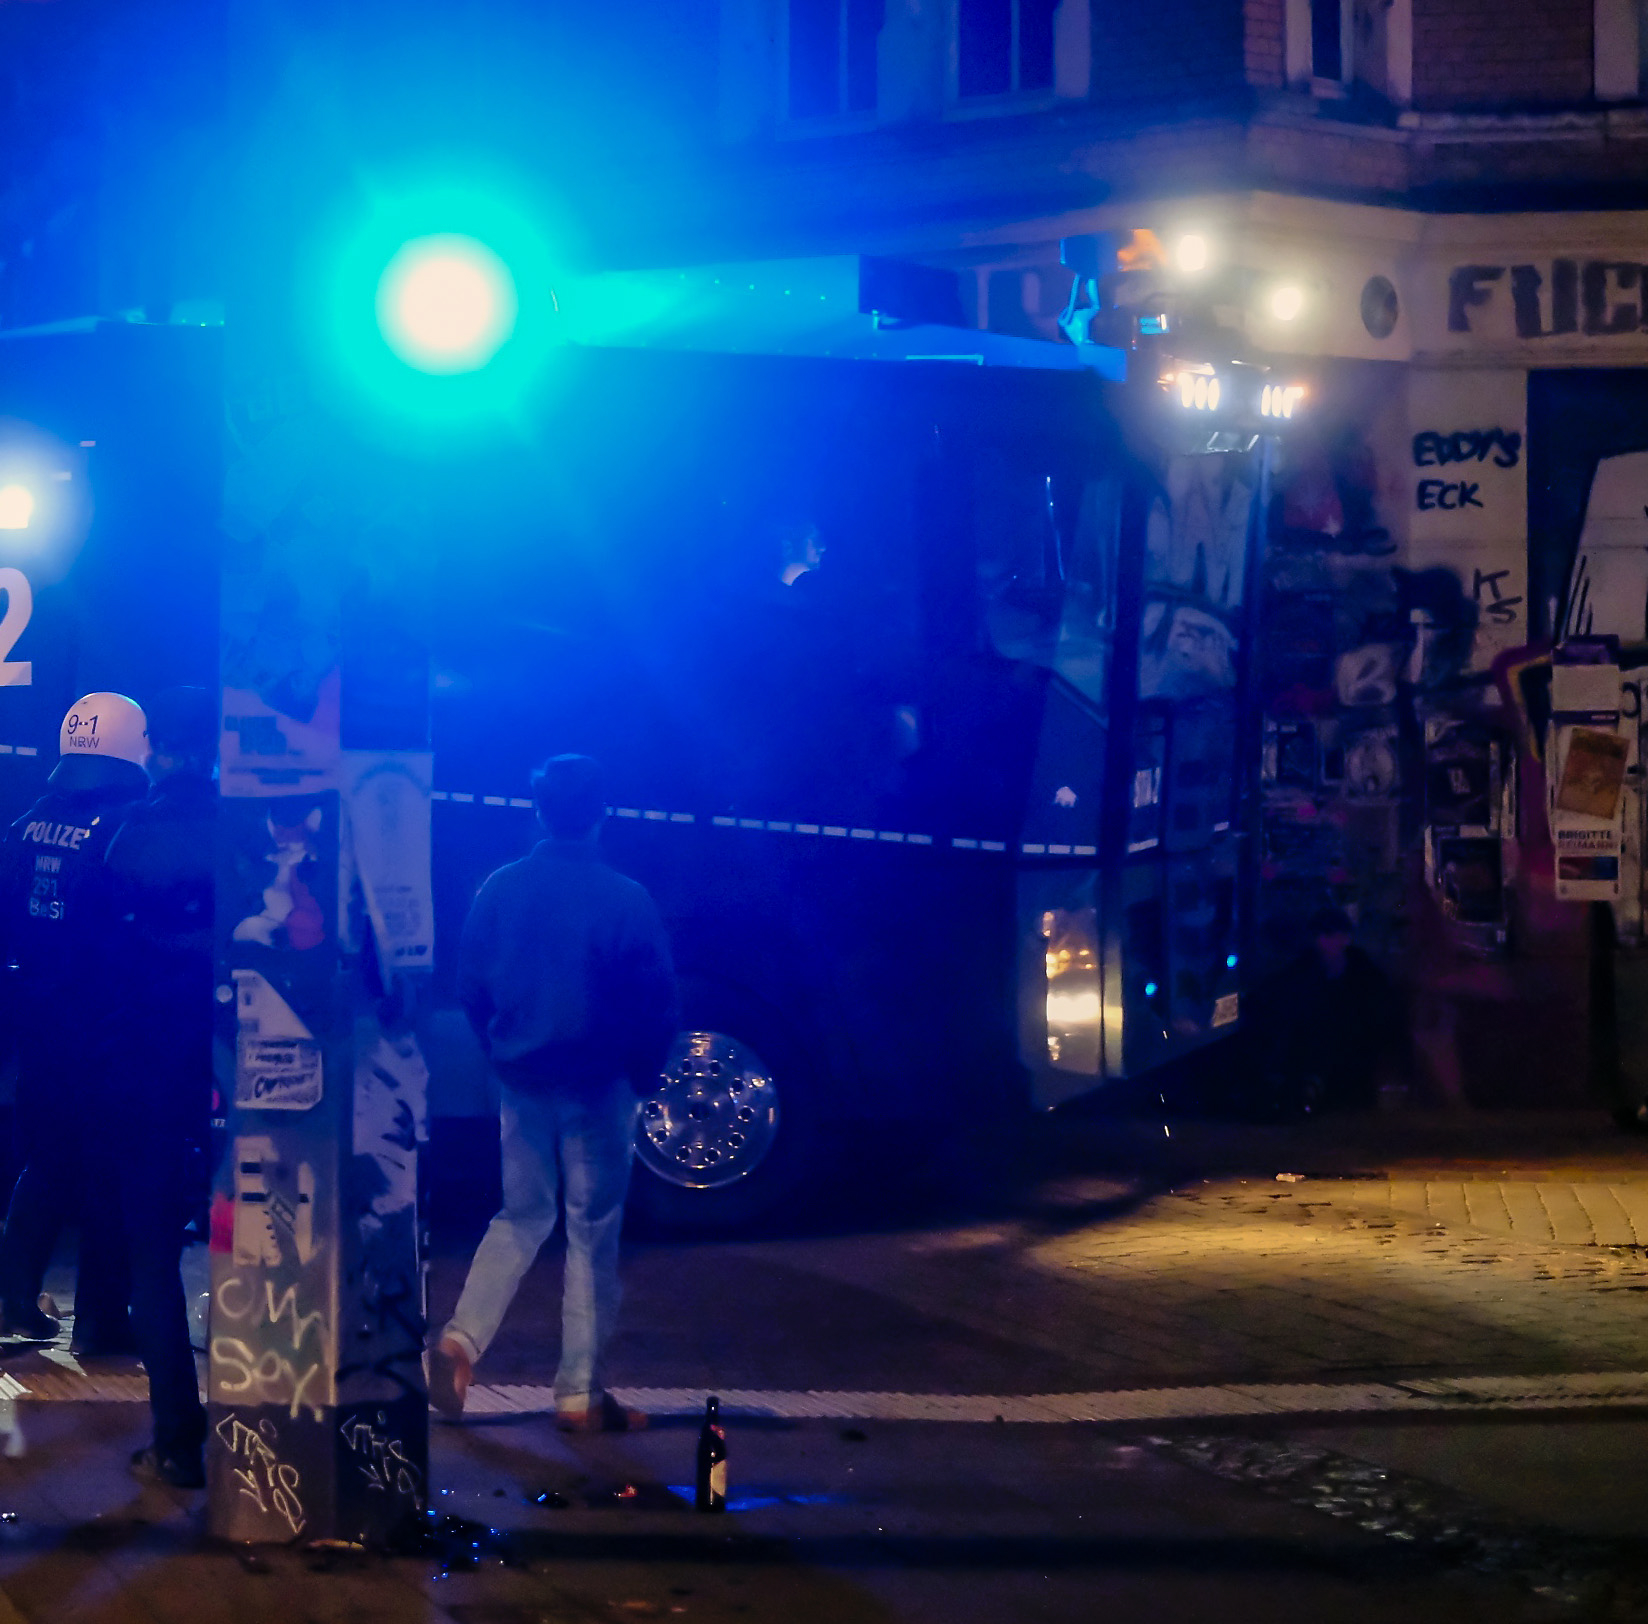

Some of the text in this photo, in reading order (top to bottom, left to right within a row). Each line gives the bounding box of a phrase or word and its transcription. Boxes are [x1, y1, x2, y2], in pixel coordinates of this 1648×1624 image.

[1448, 259, 1648, 338] FUC
[1417, 479, 1483, 510] ECK
[67, 714, 99, 735] 9-1
[69, 735, 100, 749] NRW
[35, 856, 62, 873] NRW
